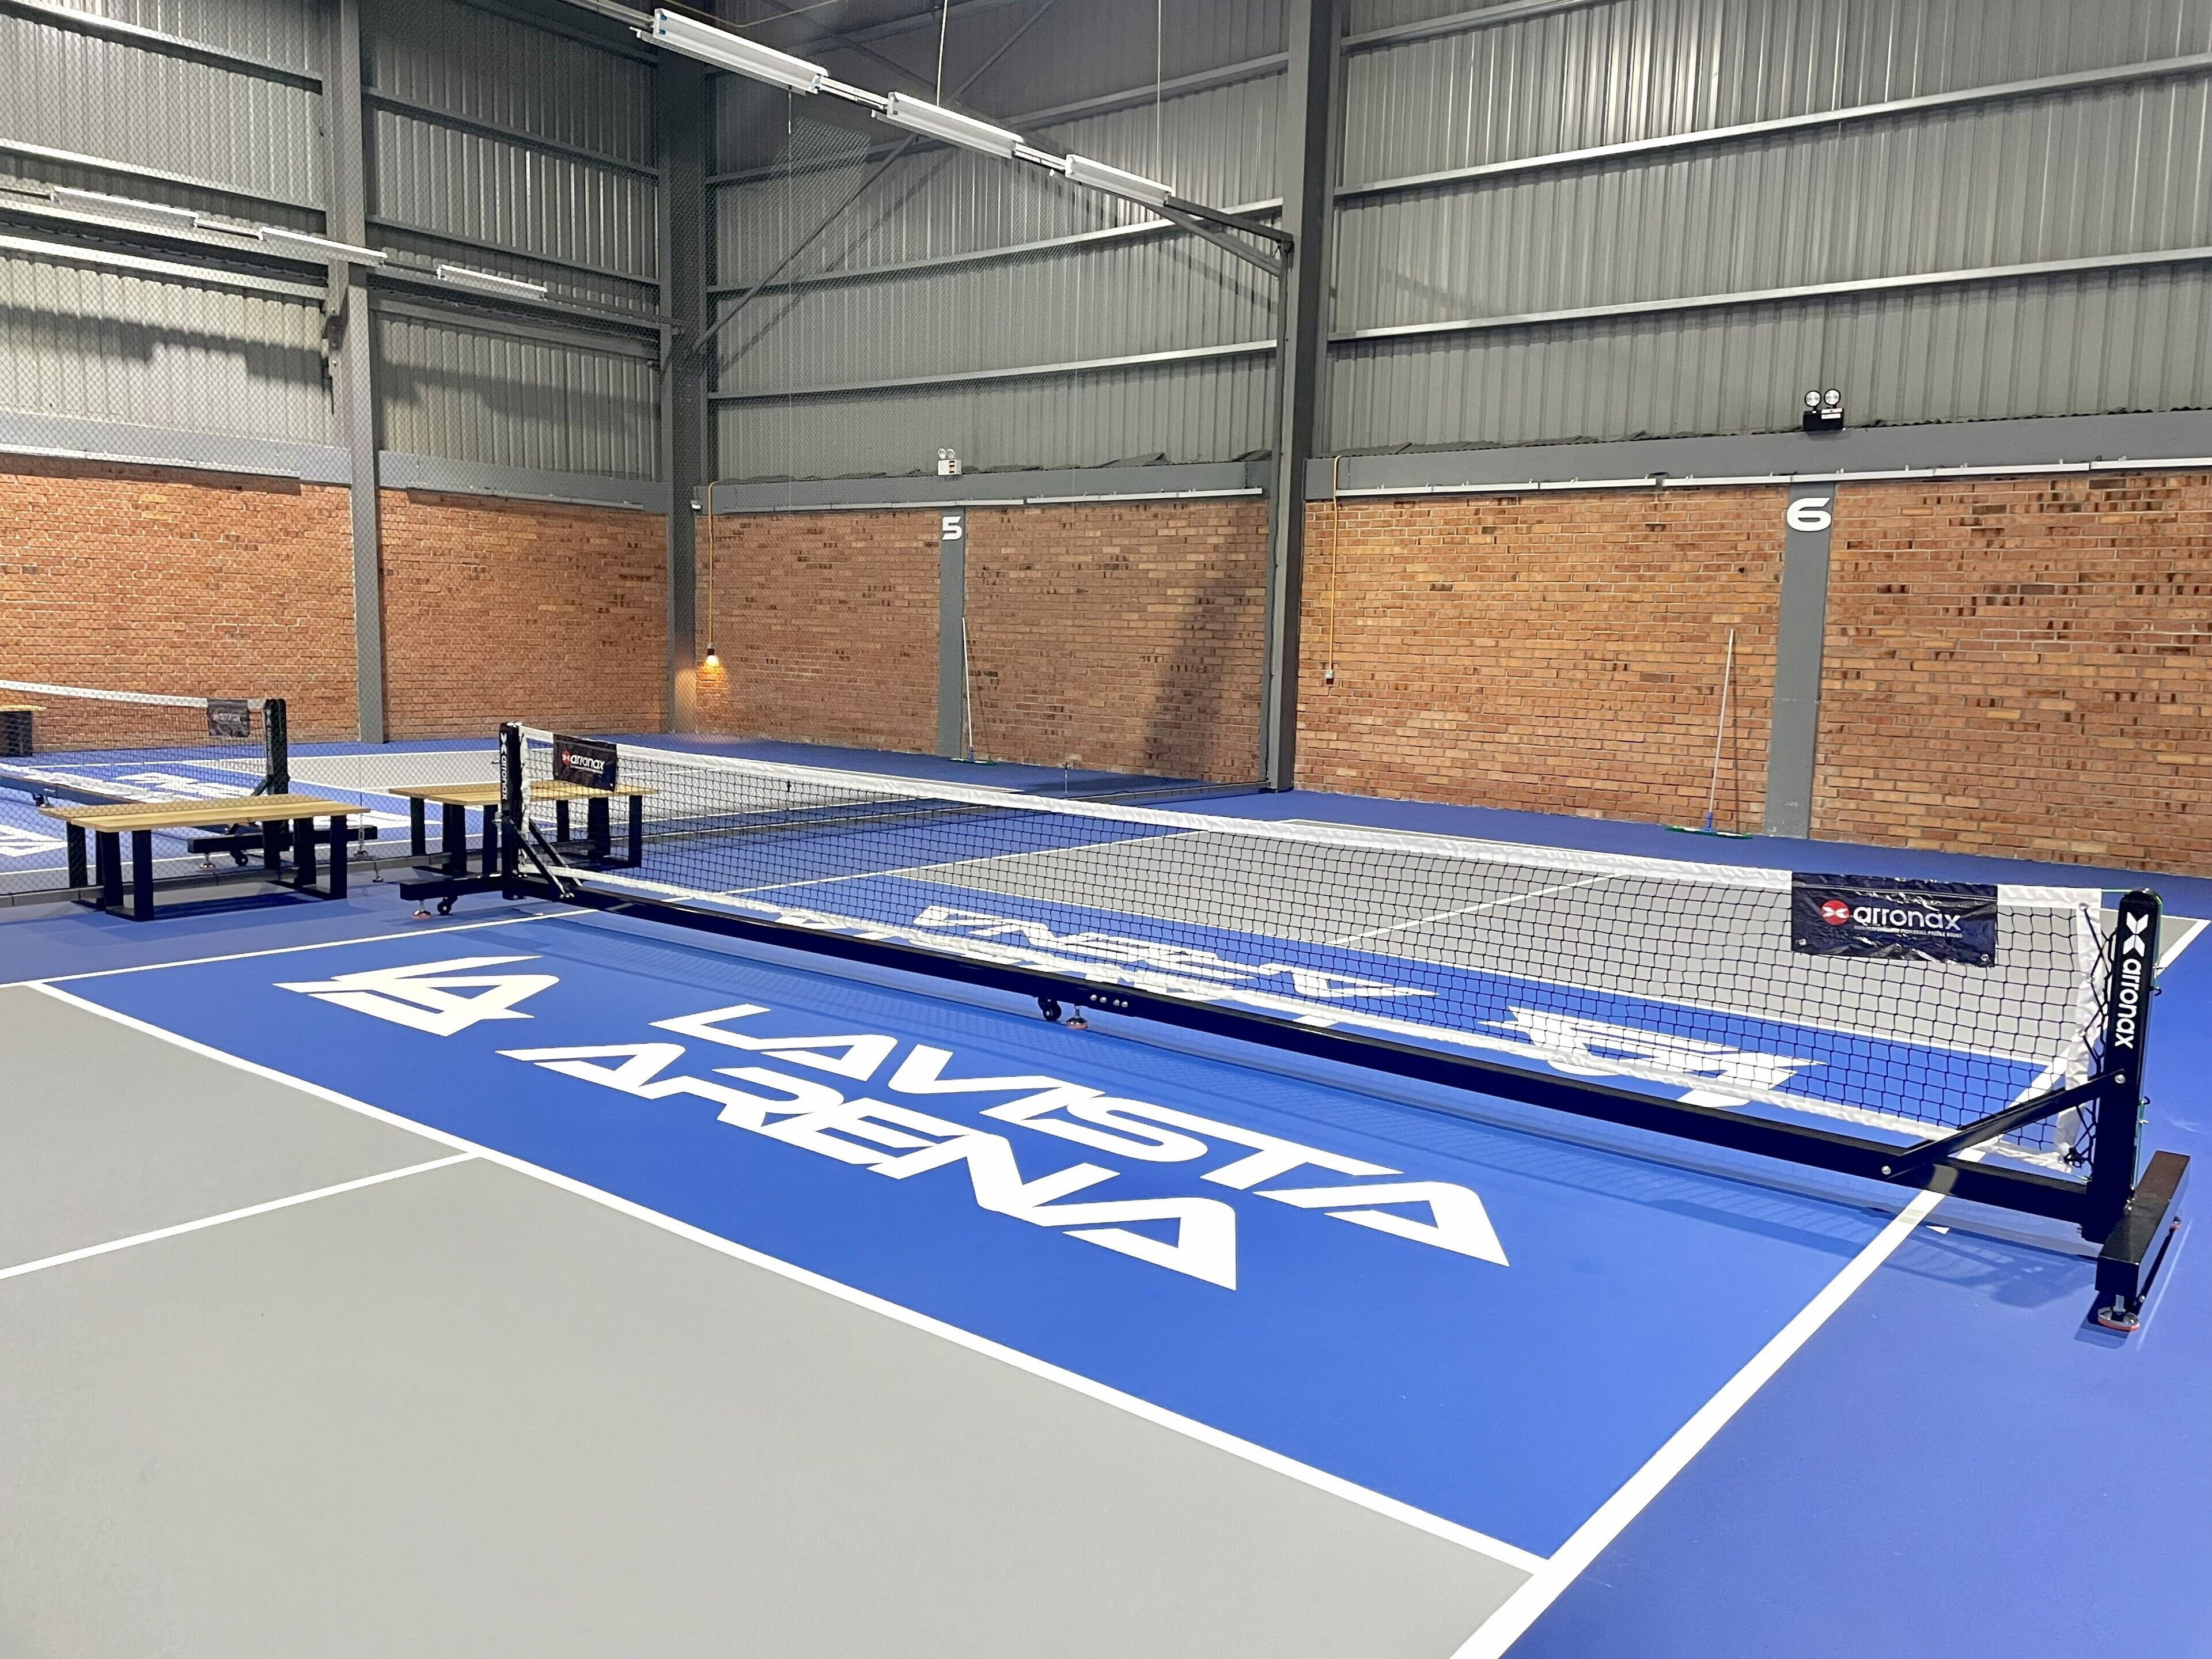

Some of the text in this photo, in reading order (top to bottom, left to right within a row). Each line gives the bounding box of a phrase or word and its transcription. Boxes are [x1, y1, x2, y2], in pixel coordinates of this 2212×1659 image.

[942, 516, 963, 540] 5
[1787, 498, 1831, 532] 6
[570, 755, 605, 770] arronax
[1853, 907, 1961, 931] arronax
[2115, 959, 2142, 1049] arronax
[649, 1004, 1509, 1267] LAVISTA
[495, 1043, 1236, 1290] ARENA
